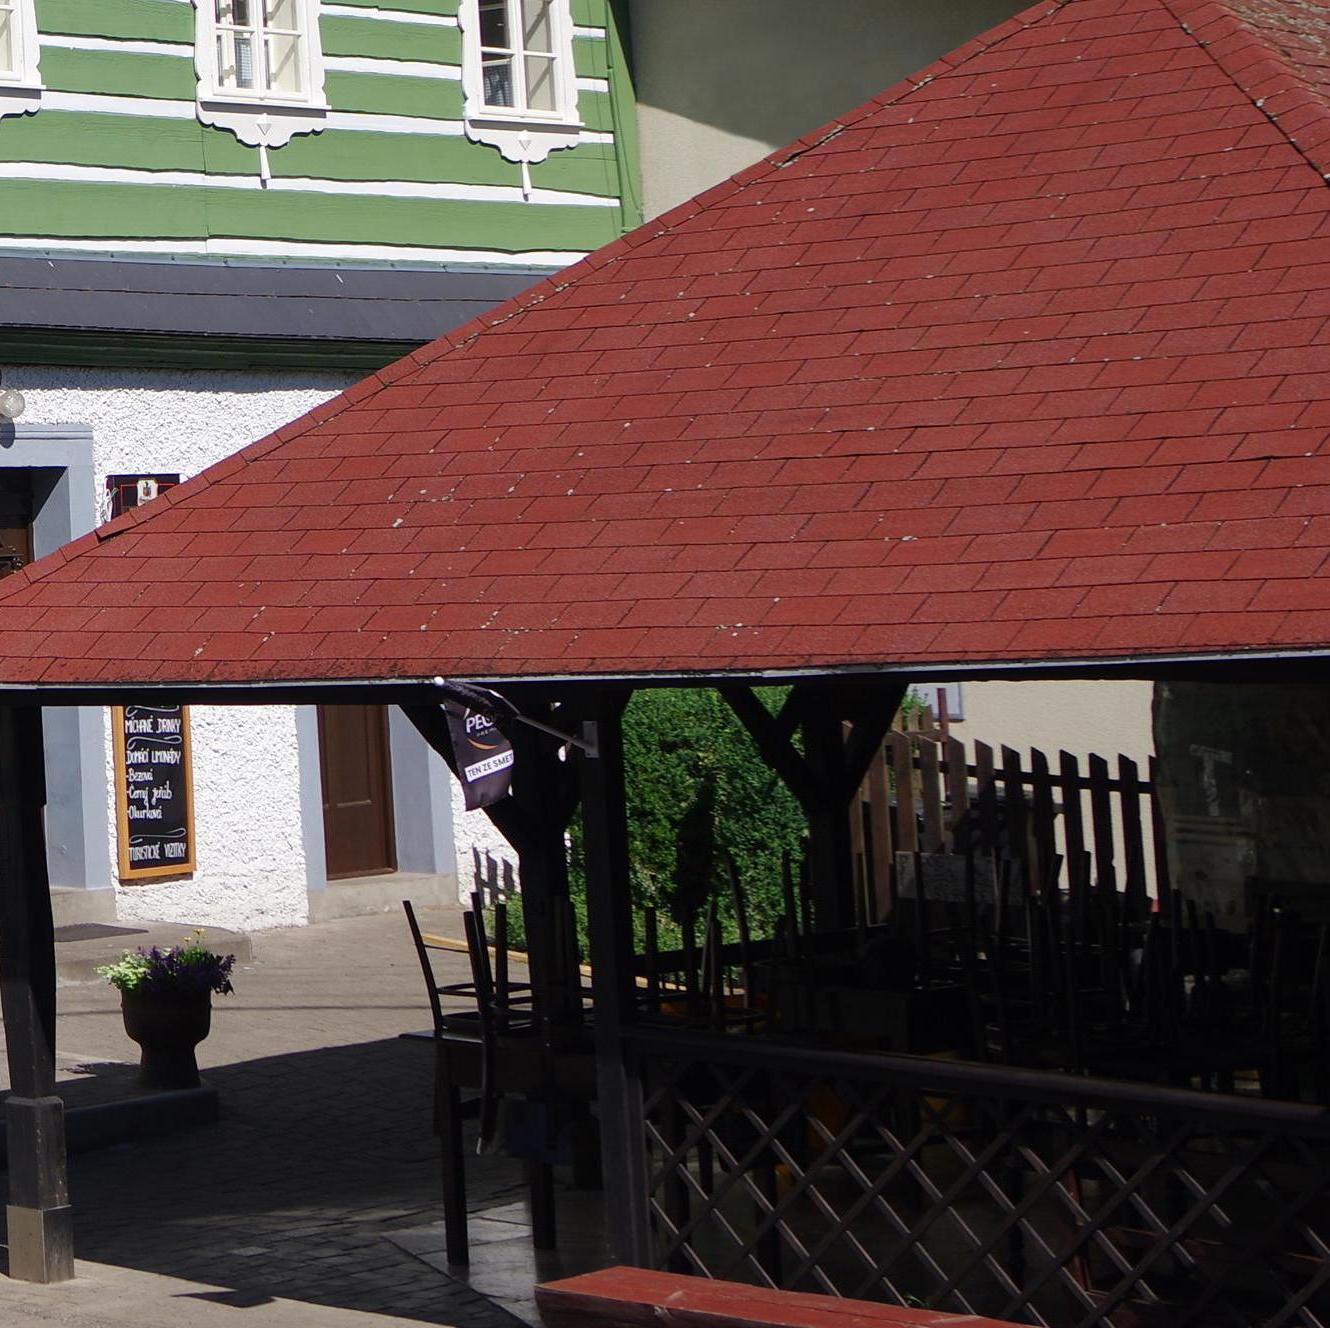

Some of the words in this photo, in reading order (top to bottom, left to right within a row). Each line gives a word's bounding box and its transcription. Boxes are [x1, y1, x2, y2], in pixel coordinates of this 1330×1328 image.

[125, 715, 153, 733] MÍCHANÉ
[156, 718, 181, 733] DRINKY
[126, 748, 149, 765] DOMÁCÍ
[468, 766, 482, 777] TEN
[482, 761, 492, 771] ZE
[492, 753, 513, 768] SMET
